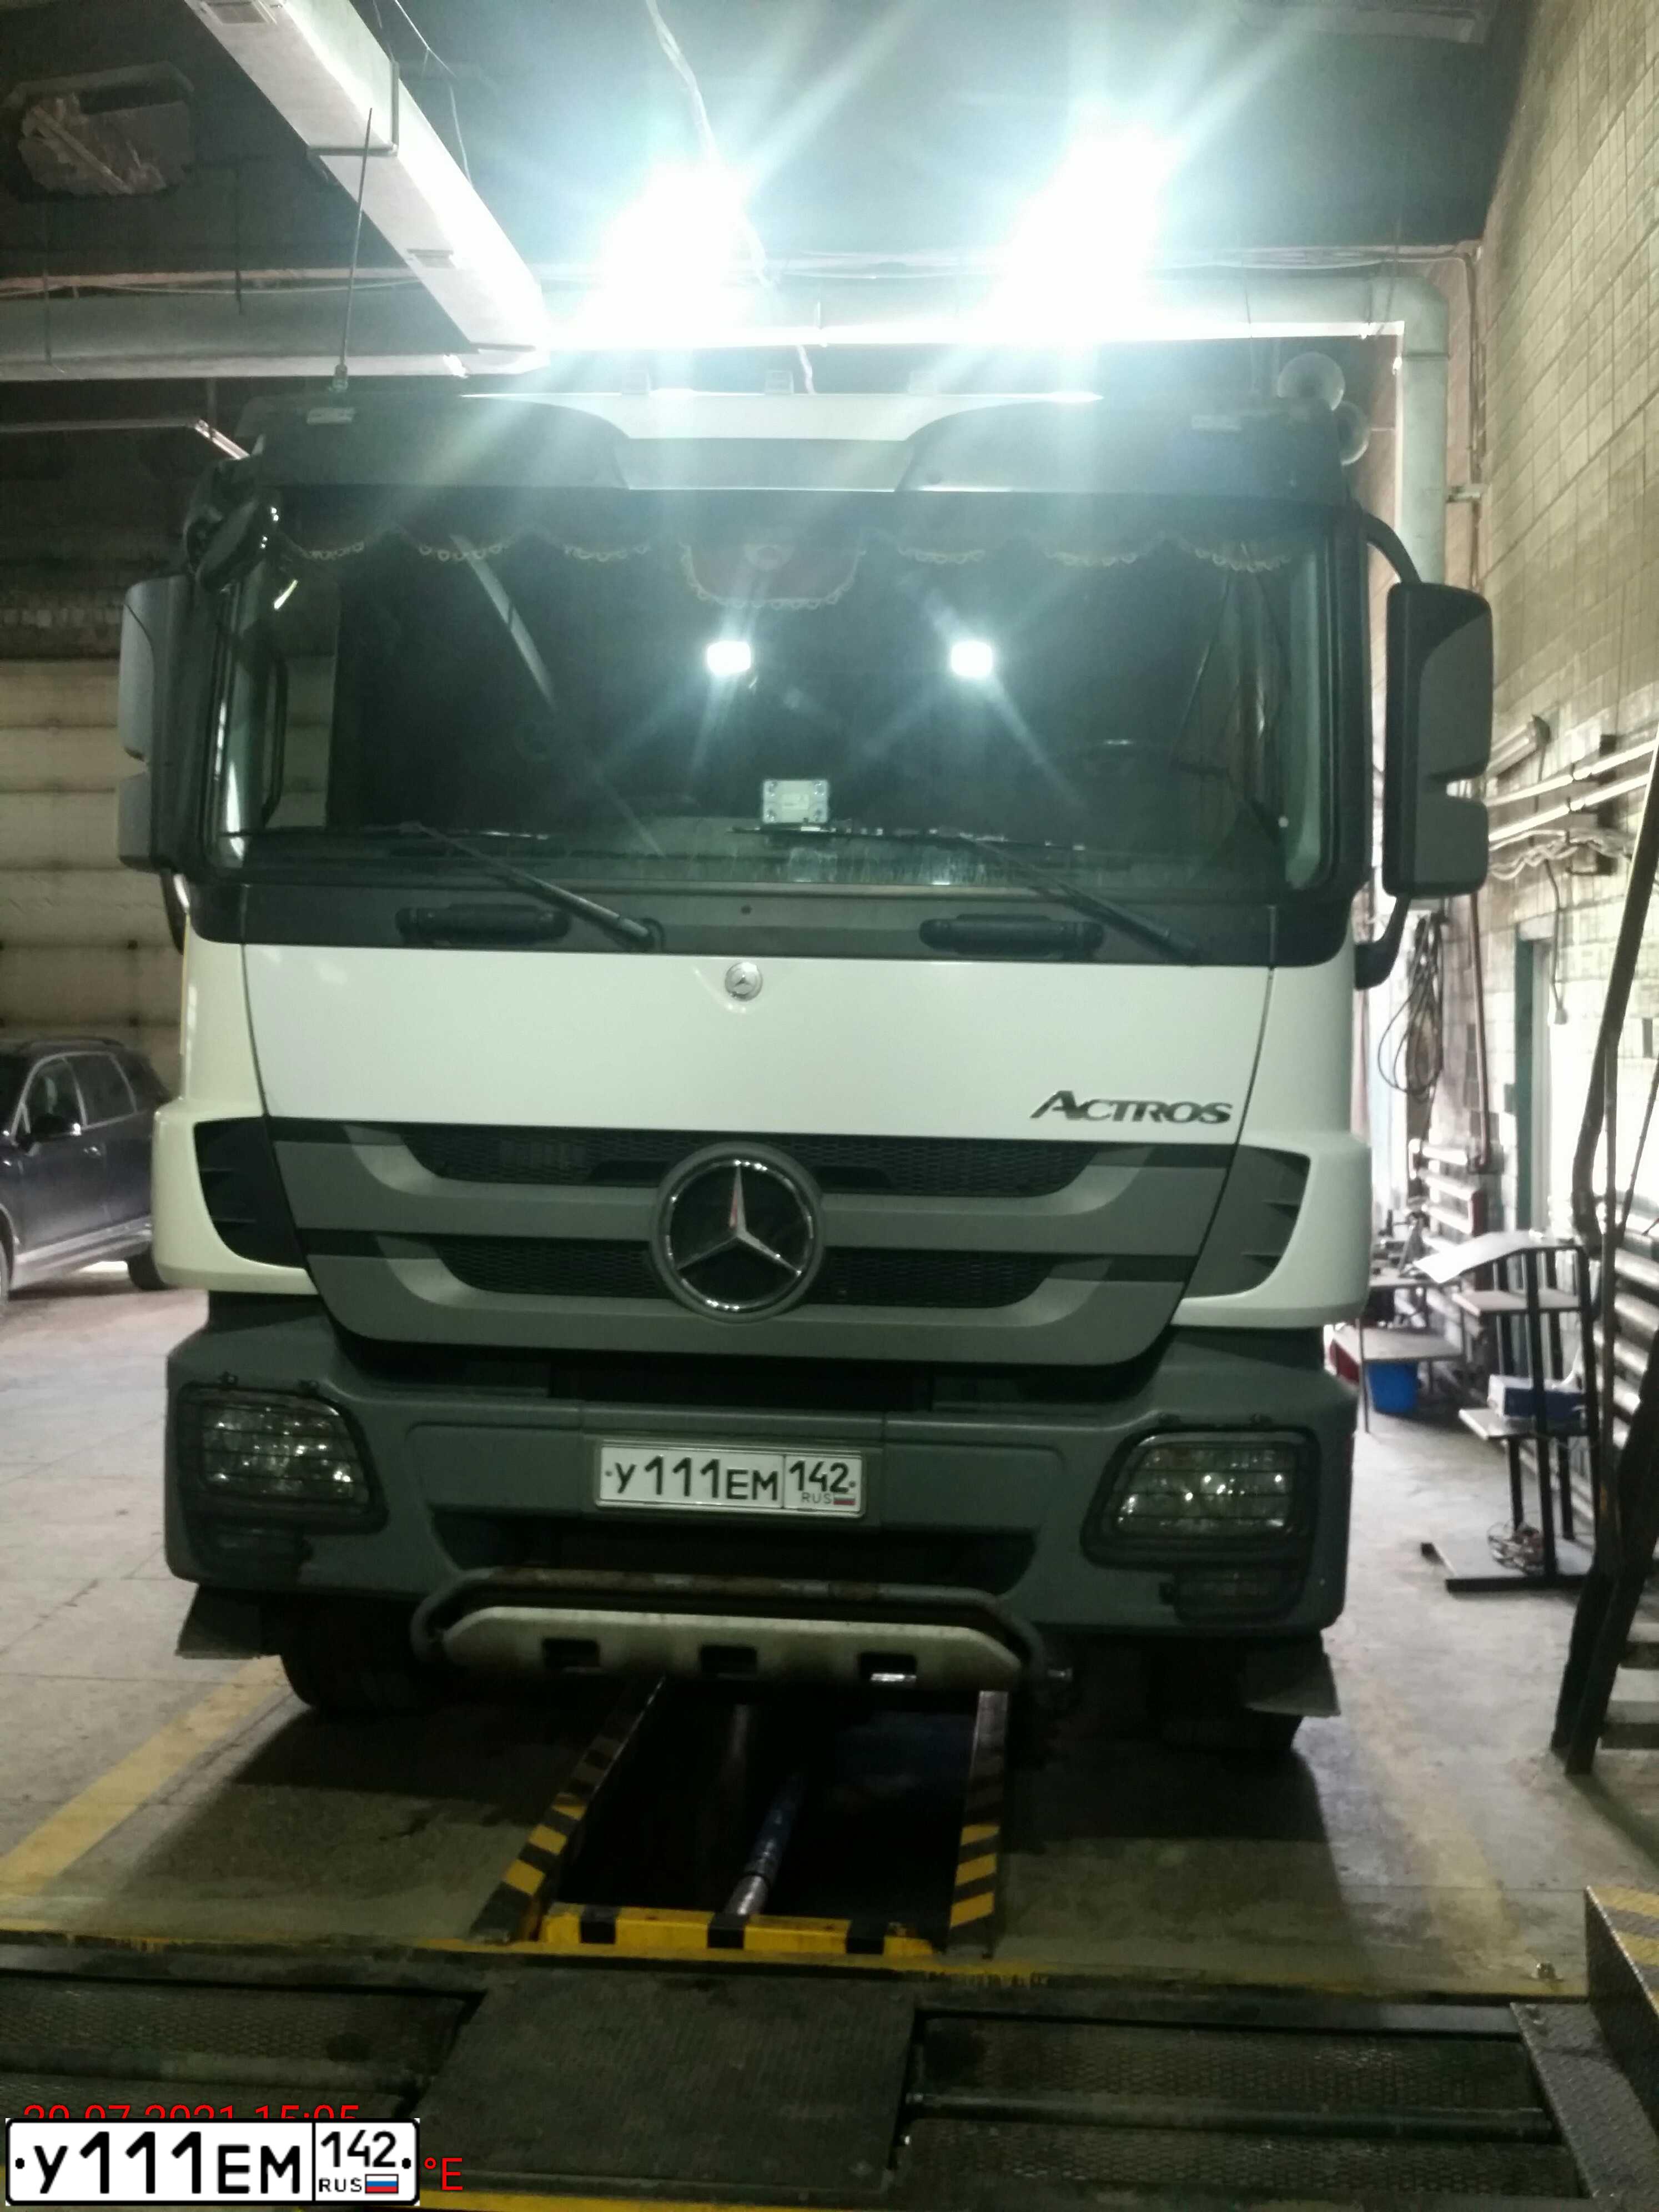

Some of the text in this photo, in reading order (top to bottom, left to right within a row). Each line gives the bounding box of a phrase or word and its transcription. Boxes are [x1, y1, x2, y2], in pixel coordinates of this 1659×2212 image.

[1030, 1090, 1233, 1124] ACTROS
[790, 1460, 849, 1493] 142
[801, 1492, 831, 1504] RUS
